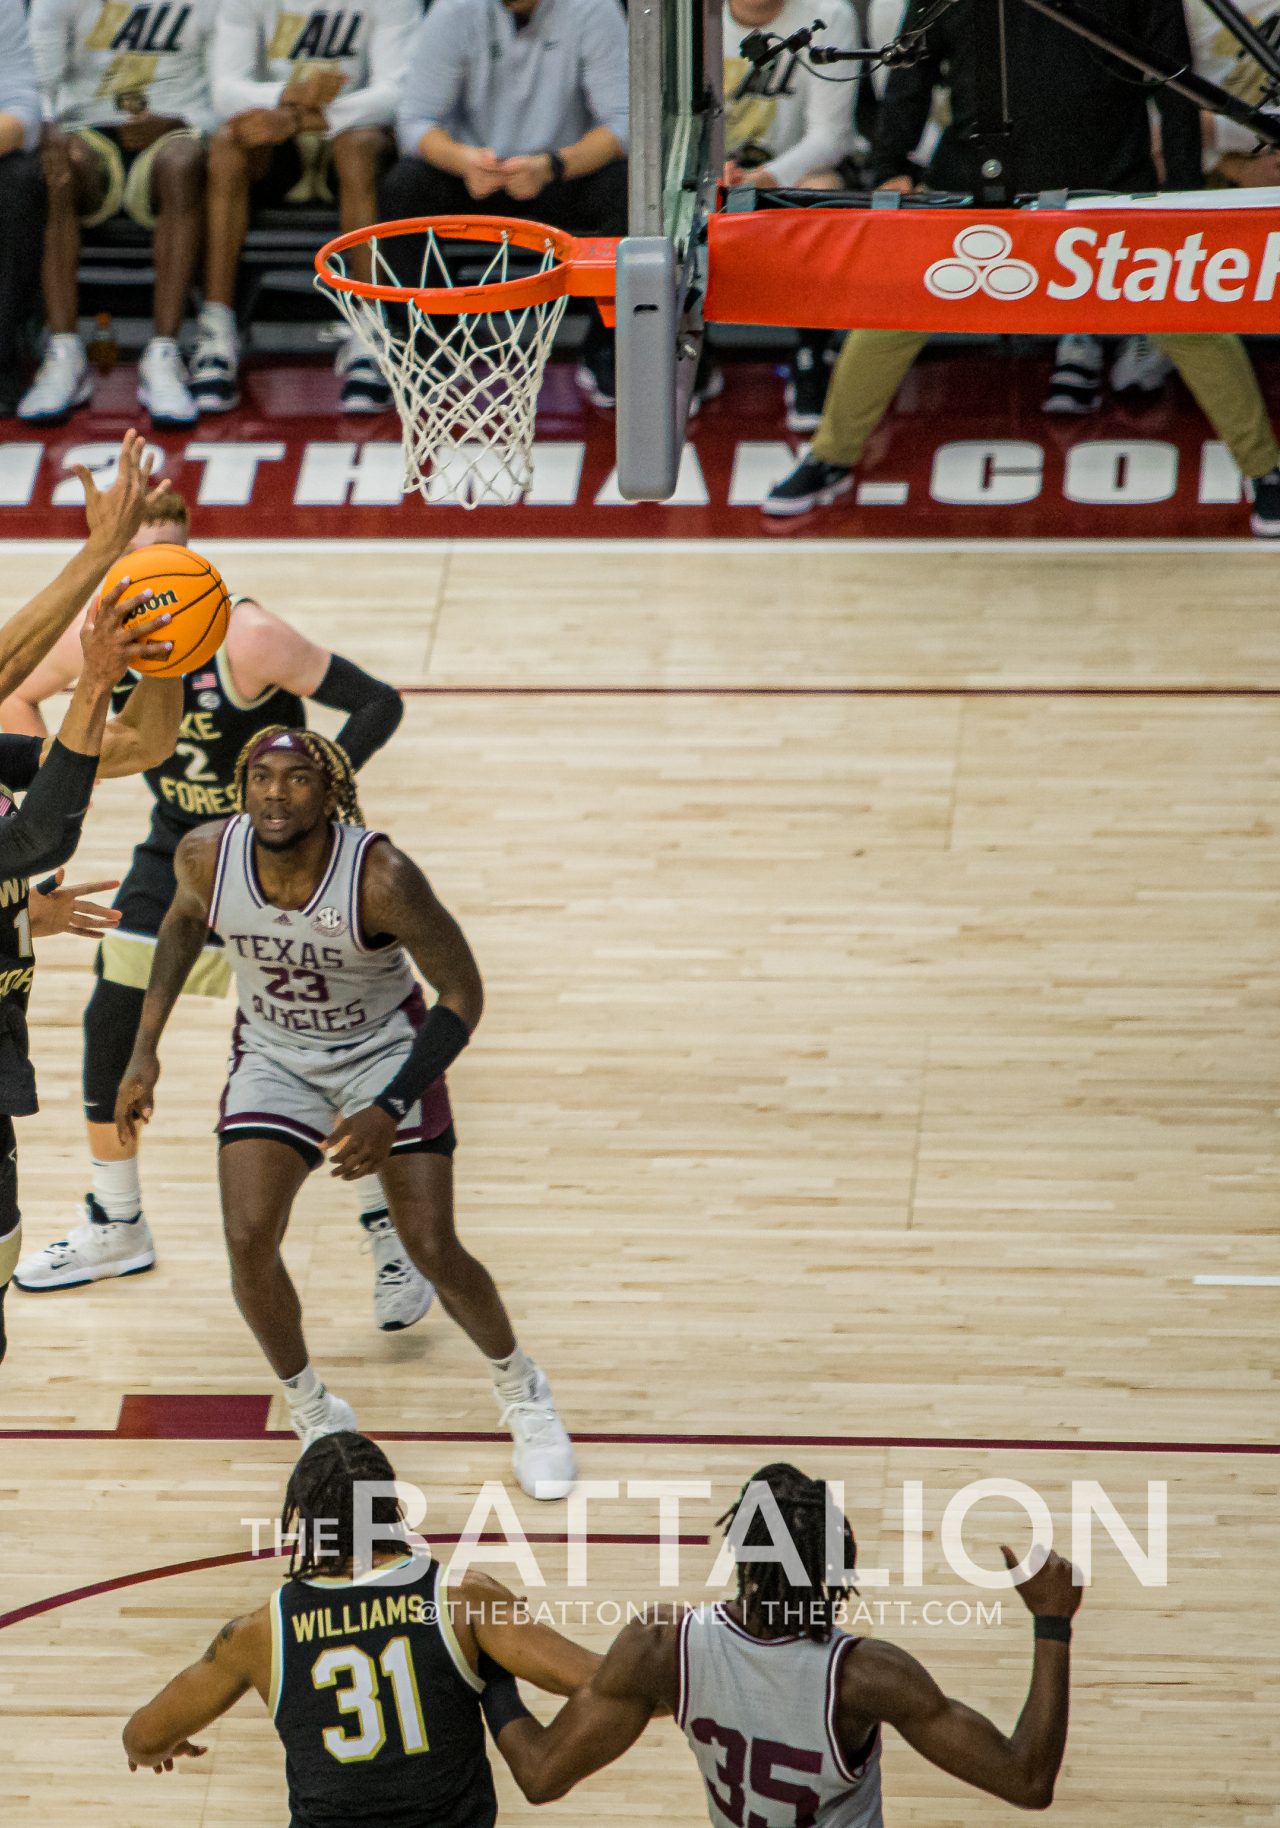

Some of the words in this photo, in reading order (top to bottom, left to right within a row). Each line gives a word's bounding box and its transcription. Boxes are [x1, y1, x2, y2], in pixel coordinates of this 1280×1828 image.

[1047, 227, 1250, 301] State
[176, 743, 218, 782] 2
[160, 776, 241, 814] FORES
[230, 934, 343, 970] TEXAS
[260, 966, 329, 1003] 23
[292, 1595, 424, 1643] WILLIAMS
[311, 1636, 430, 1764] 31
[690, 1717, 823, 1828] 35
